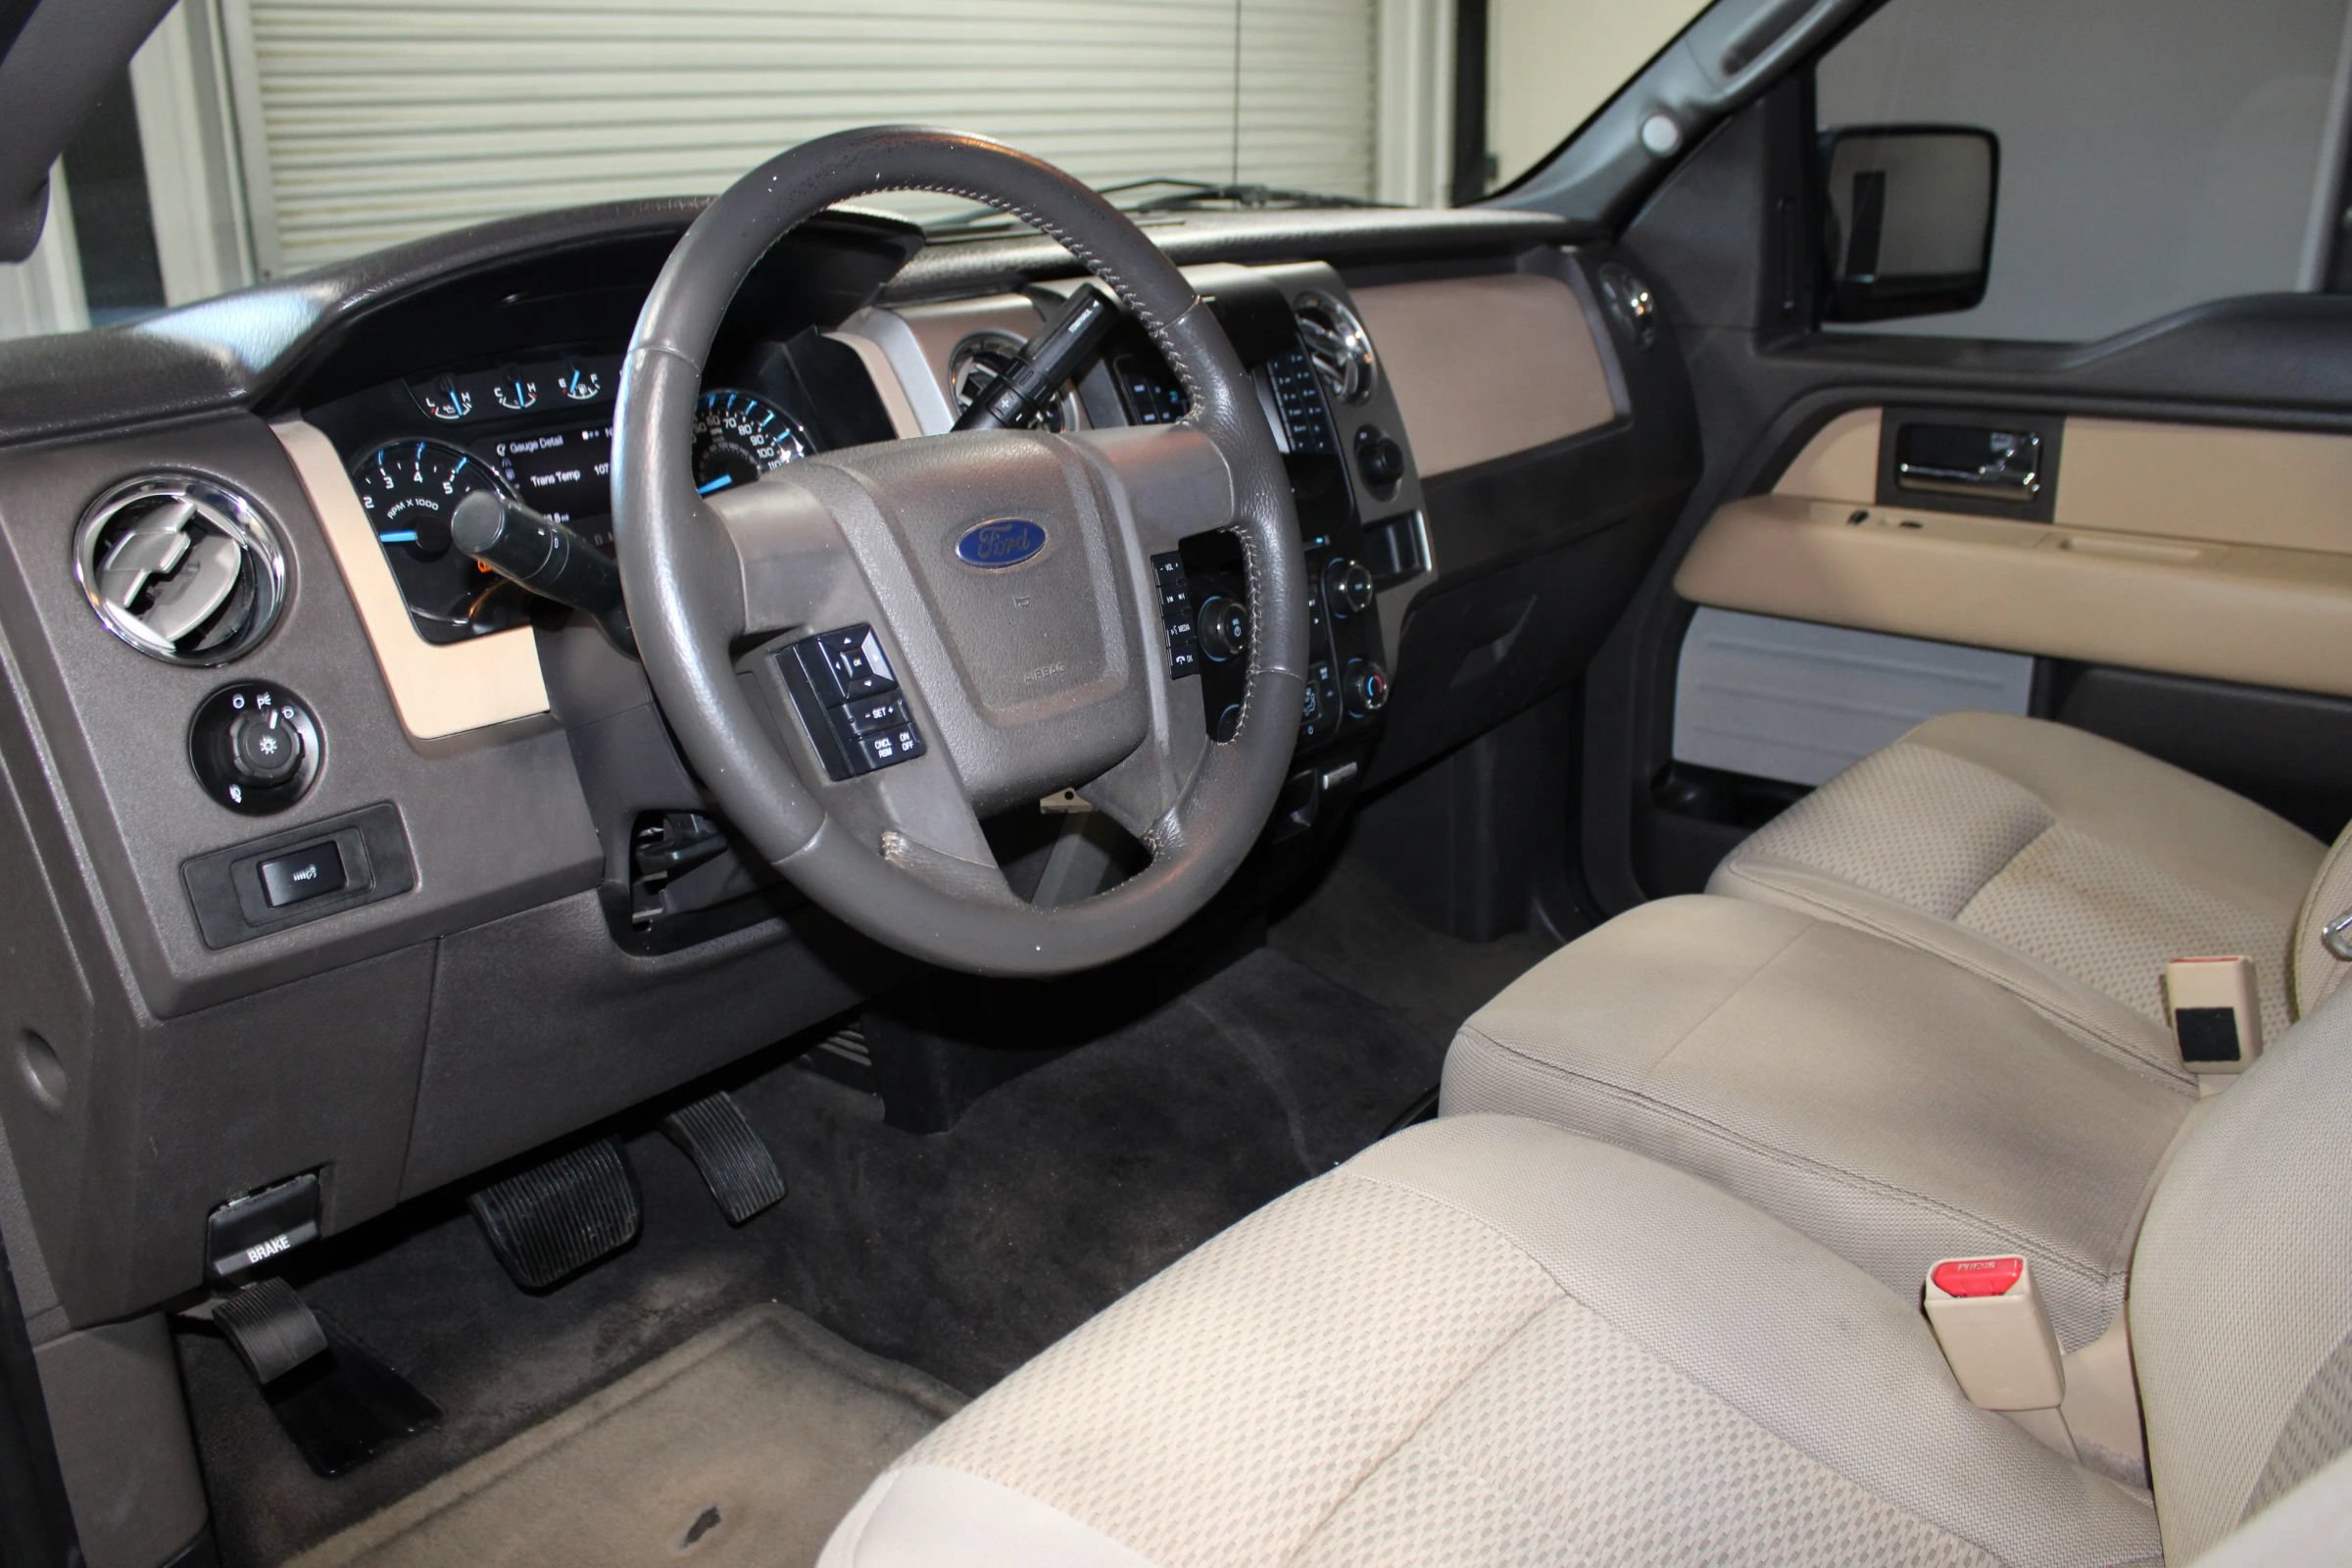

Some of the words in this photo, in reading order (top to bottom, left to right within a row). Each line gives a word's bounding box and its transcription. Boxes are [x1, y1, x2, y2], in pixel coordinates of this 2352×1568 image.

[494, 387, 503, 398] C
[527, 382, 537, 393] H
[425, 397, 435, 408] L
[461, 392, 471, 403] H
[723, 417, 737, 429] 70
[738, 423, 753, 436] 80
[510, 440, 539, 454] Gauge
[539, 434, 564, 449] Detail
[750, 434, 764, 447] 90
[757, 447, 774, 459] 100
[383, 476, 394, 489] 3
[414, 471, 423, 483] 4
[530, 474, 557, 488] Trans
[555, 469, 581, 483] Temp
[442, 481, 453, 494] 5
[363, 496, 374, 509] 2
[387, 501, 406, 519] RPM
[406, 498, 414, 507] X
[415, 498, 439, 511] 1000
[977, 523, 1030, 560] Ford
[853, 659, 862, 667] OK
[872, 707, 887, 719] SET
[899, 732, 910, 743] ON
[902, 740, 913, 752] OFF
[246, 1235, 291, 1264] BRAKE
